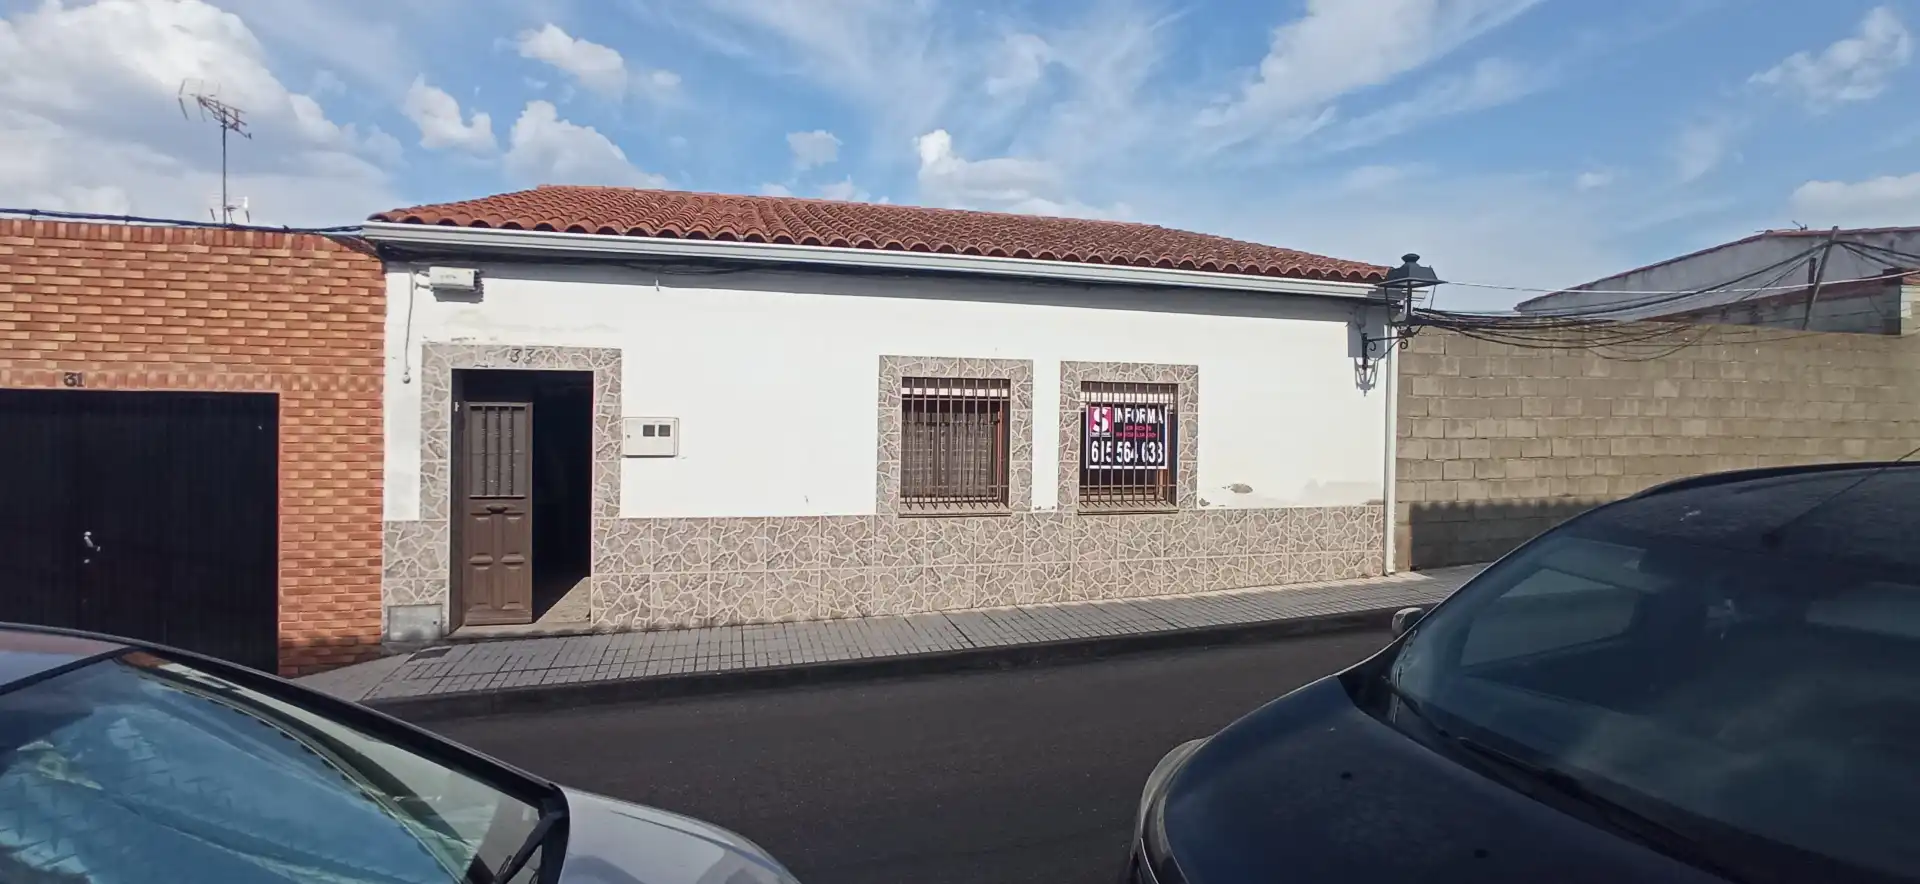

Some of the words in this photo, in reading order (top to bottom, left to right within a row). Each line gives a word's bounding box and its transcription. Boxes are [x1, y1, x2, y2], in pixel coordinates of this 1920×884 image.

[510, 348, 535, 365] 33
[63, 372, 84, 388] 31
[1092, 407, 1110, 432] S
[1114, 407, 1164, 424] INFORMA
[1091, 440, 1113, 463] 615
[1116, 441, 1139, 463] 564
